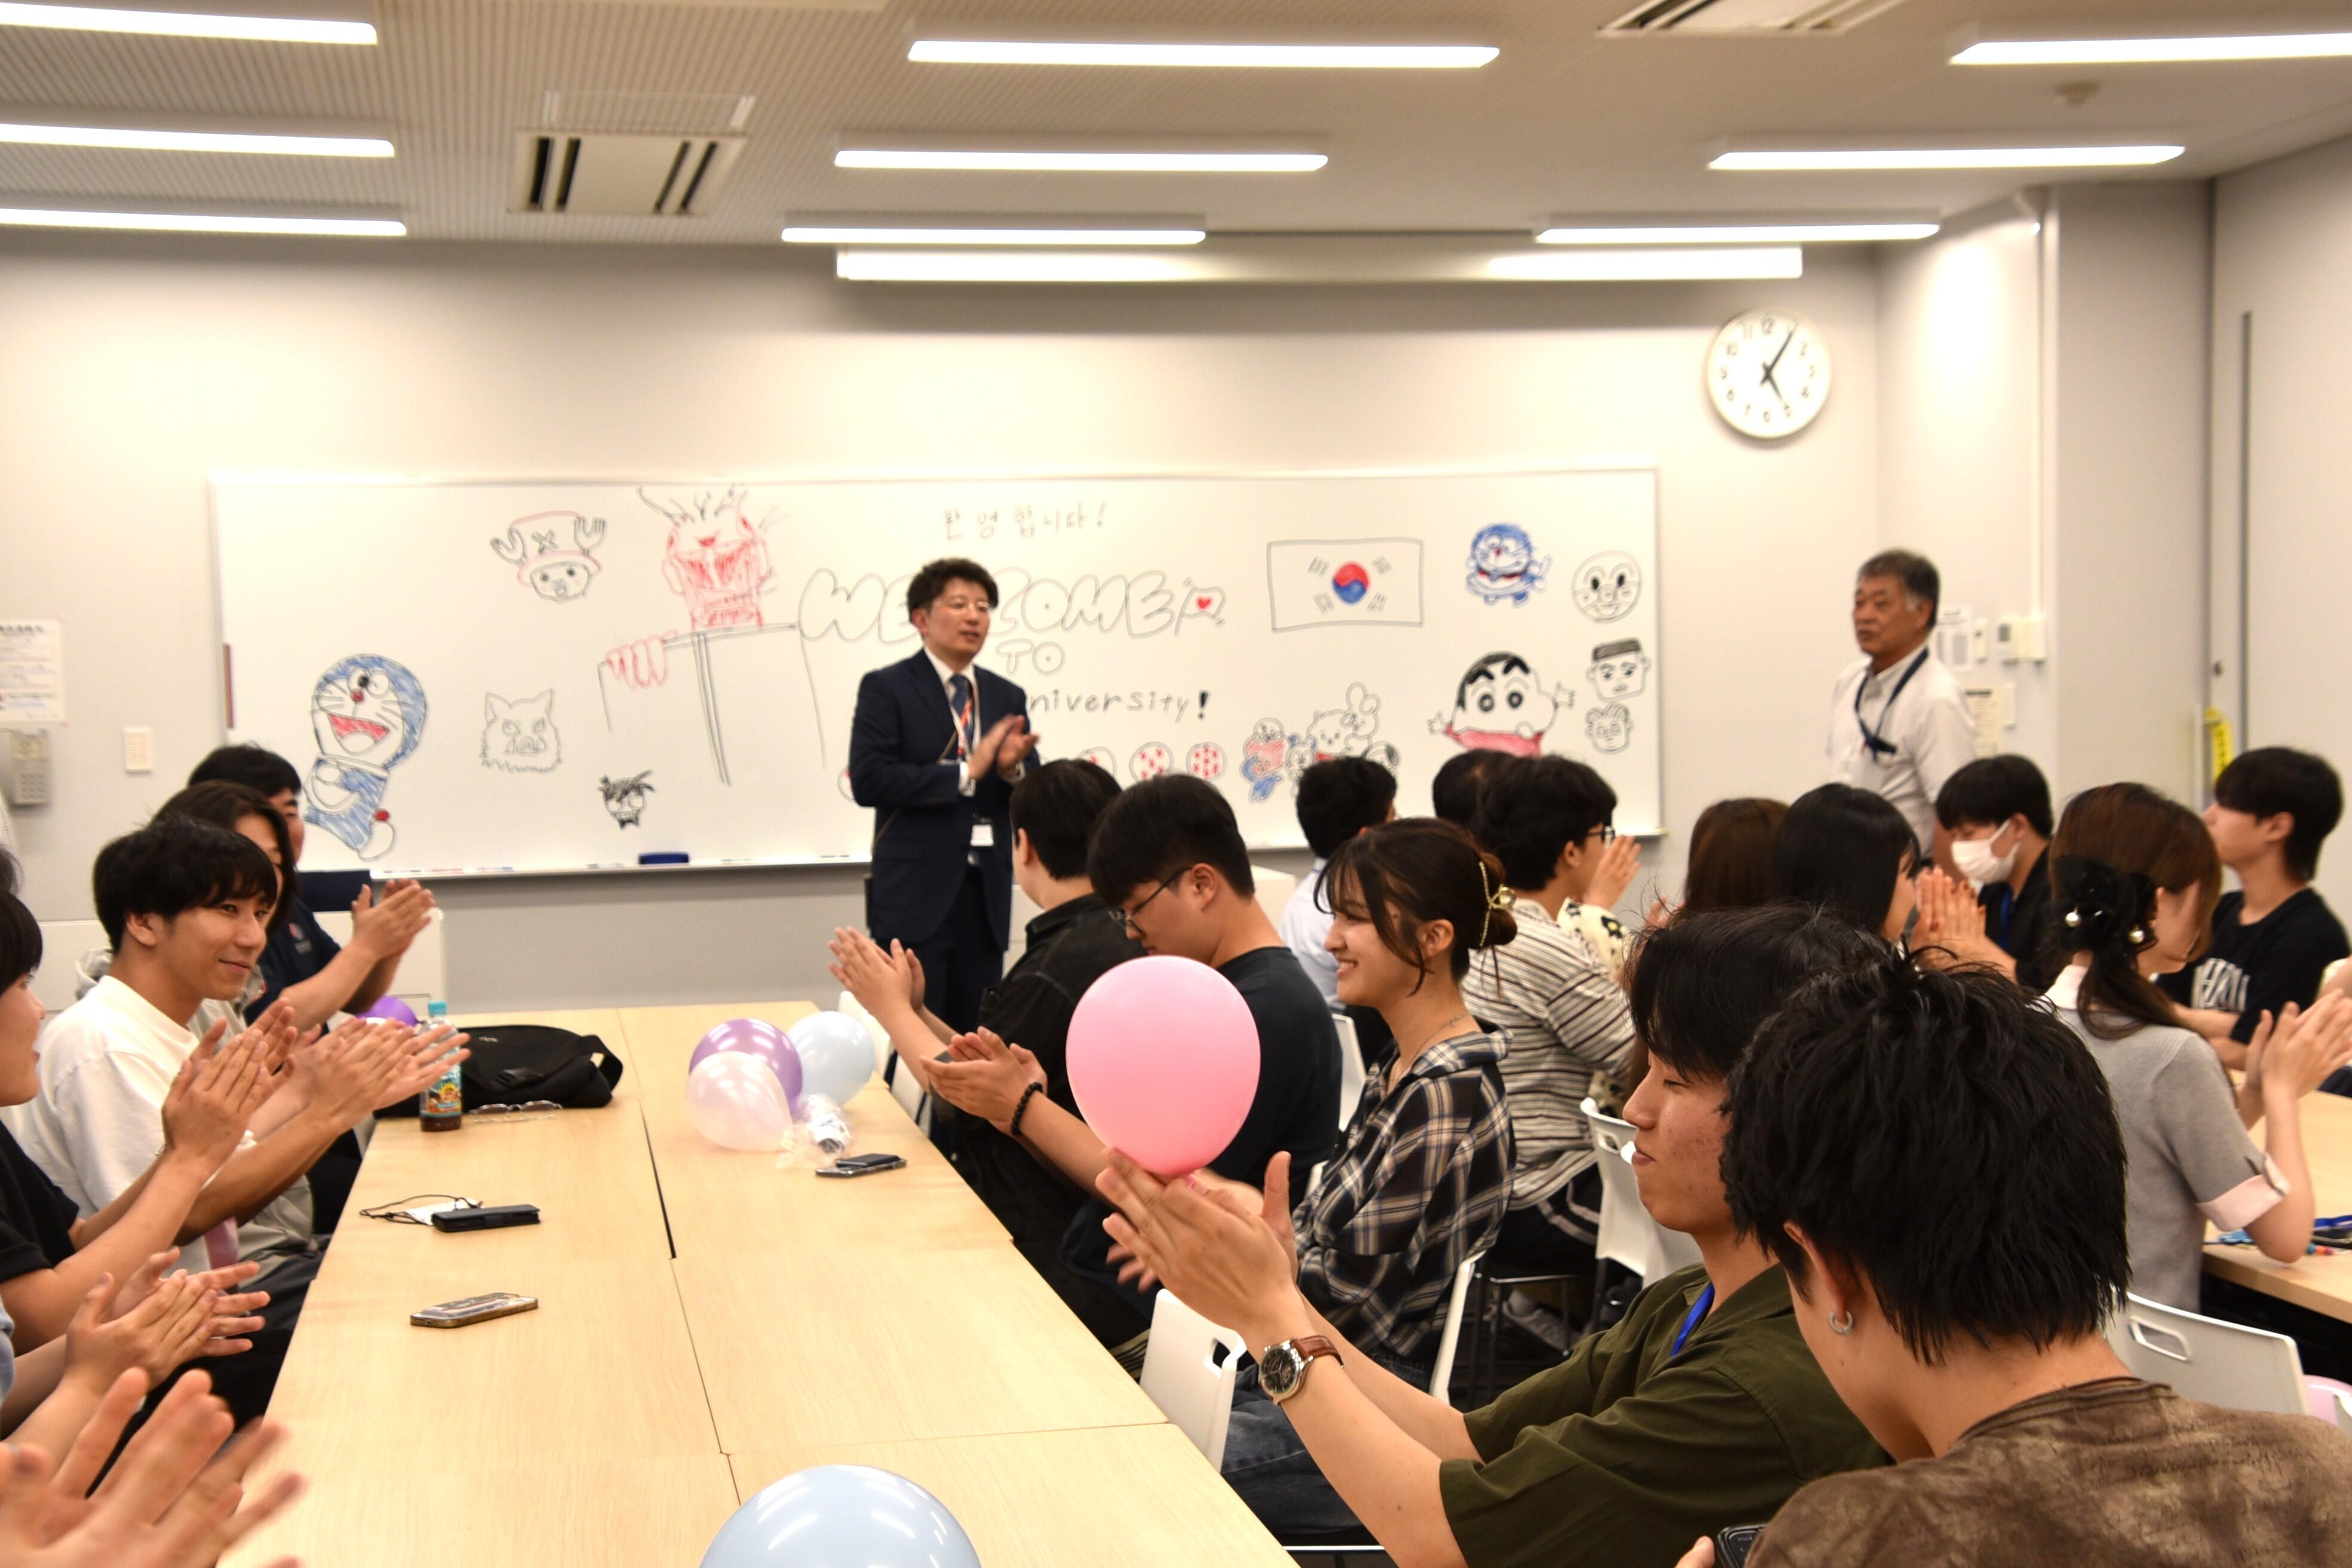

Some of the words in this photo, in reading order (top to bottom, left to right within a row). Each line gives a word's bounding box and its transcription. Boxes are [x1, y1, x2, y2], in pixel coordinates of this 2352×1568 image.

[943, 501, 1108, 541] 환영합니다!
[798, 566, 1176, 644] WECOME
[995, 638, 1066, 676] TO
[1027, 689, 1209, 725] niversity!
